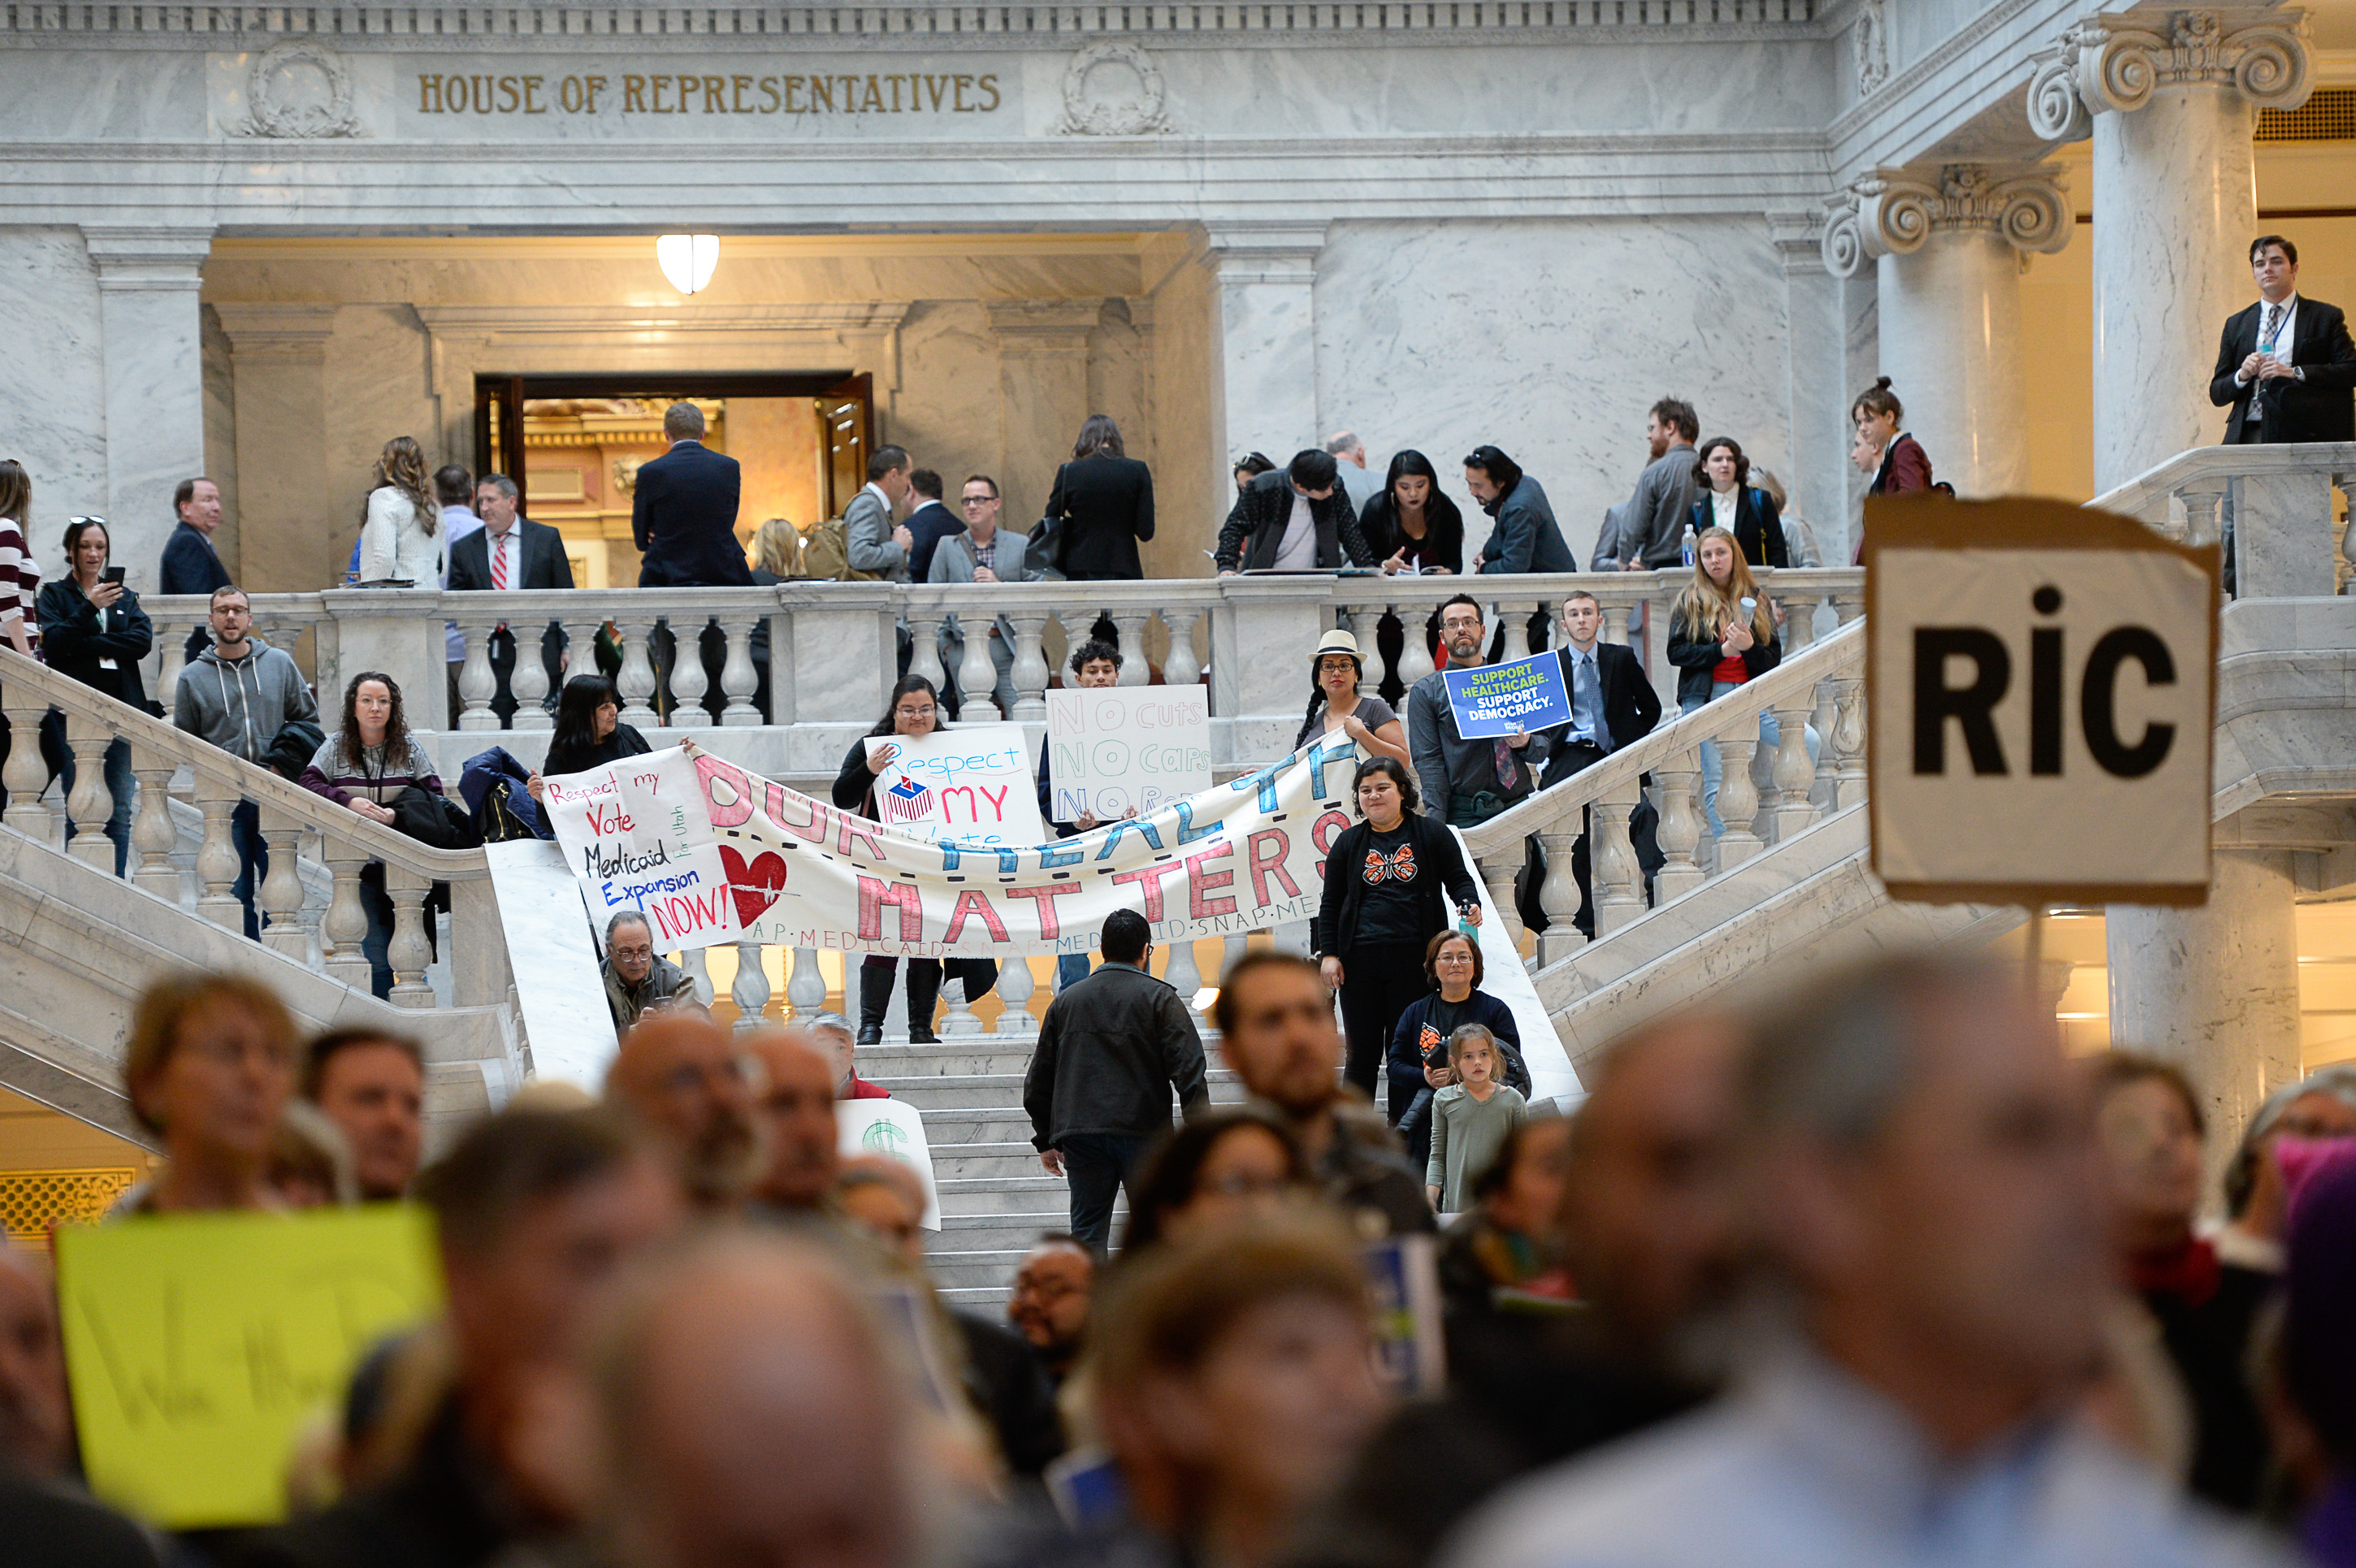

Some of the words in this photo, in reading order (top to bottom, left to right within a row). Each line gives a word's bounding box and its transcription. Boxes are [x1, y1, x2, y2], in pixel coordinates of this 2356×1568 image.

[418, 74, 547, 113] HOUSE
[561, 74, 609, 113] OF
[622, 73, 1001, 112] REPRESENTATIVES
[1461, 673, 1549, 699] HEALTHCARE.
[1471, 663, 1532, 685] SUPPORT
[1051, 695, 1126, 735] NO
[1468, 696, 1553, 721] DEMOCRACY.
[1476, 687, 1538, 708] SUPPORT
[882, 743, 1019, 785] Respect
[1055, 739, 1130, 778] NO
[548, 771, 618, 808] Respect
[634, 773, 660, 795] my
[693, 755, 886, 860] OUR
[1058, 786, 1129, 821] NO
[586, 803, 636, 837] Vote
[672, 805, 686, 837] Utah
[584, 839, 671, 879] Medicaid
[856, 810, 1351, 943] MATTERS
[601, 870, 700, 912] Expansion
[652, 882, 729, 940] NOW!
[800, 929, 946, 957] MEDICAID
[962, 939, 1040, 955] SNAP
[1197, 908, 1267, 935] SNAP
